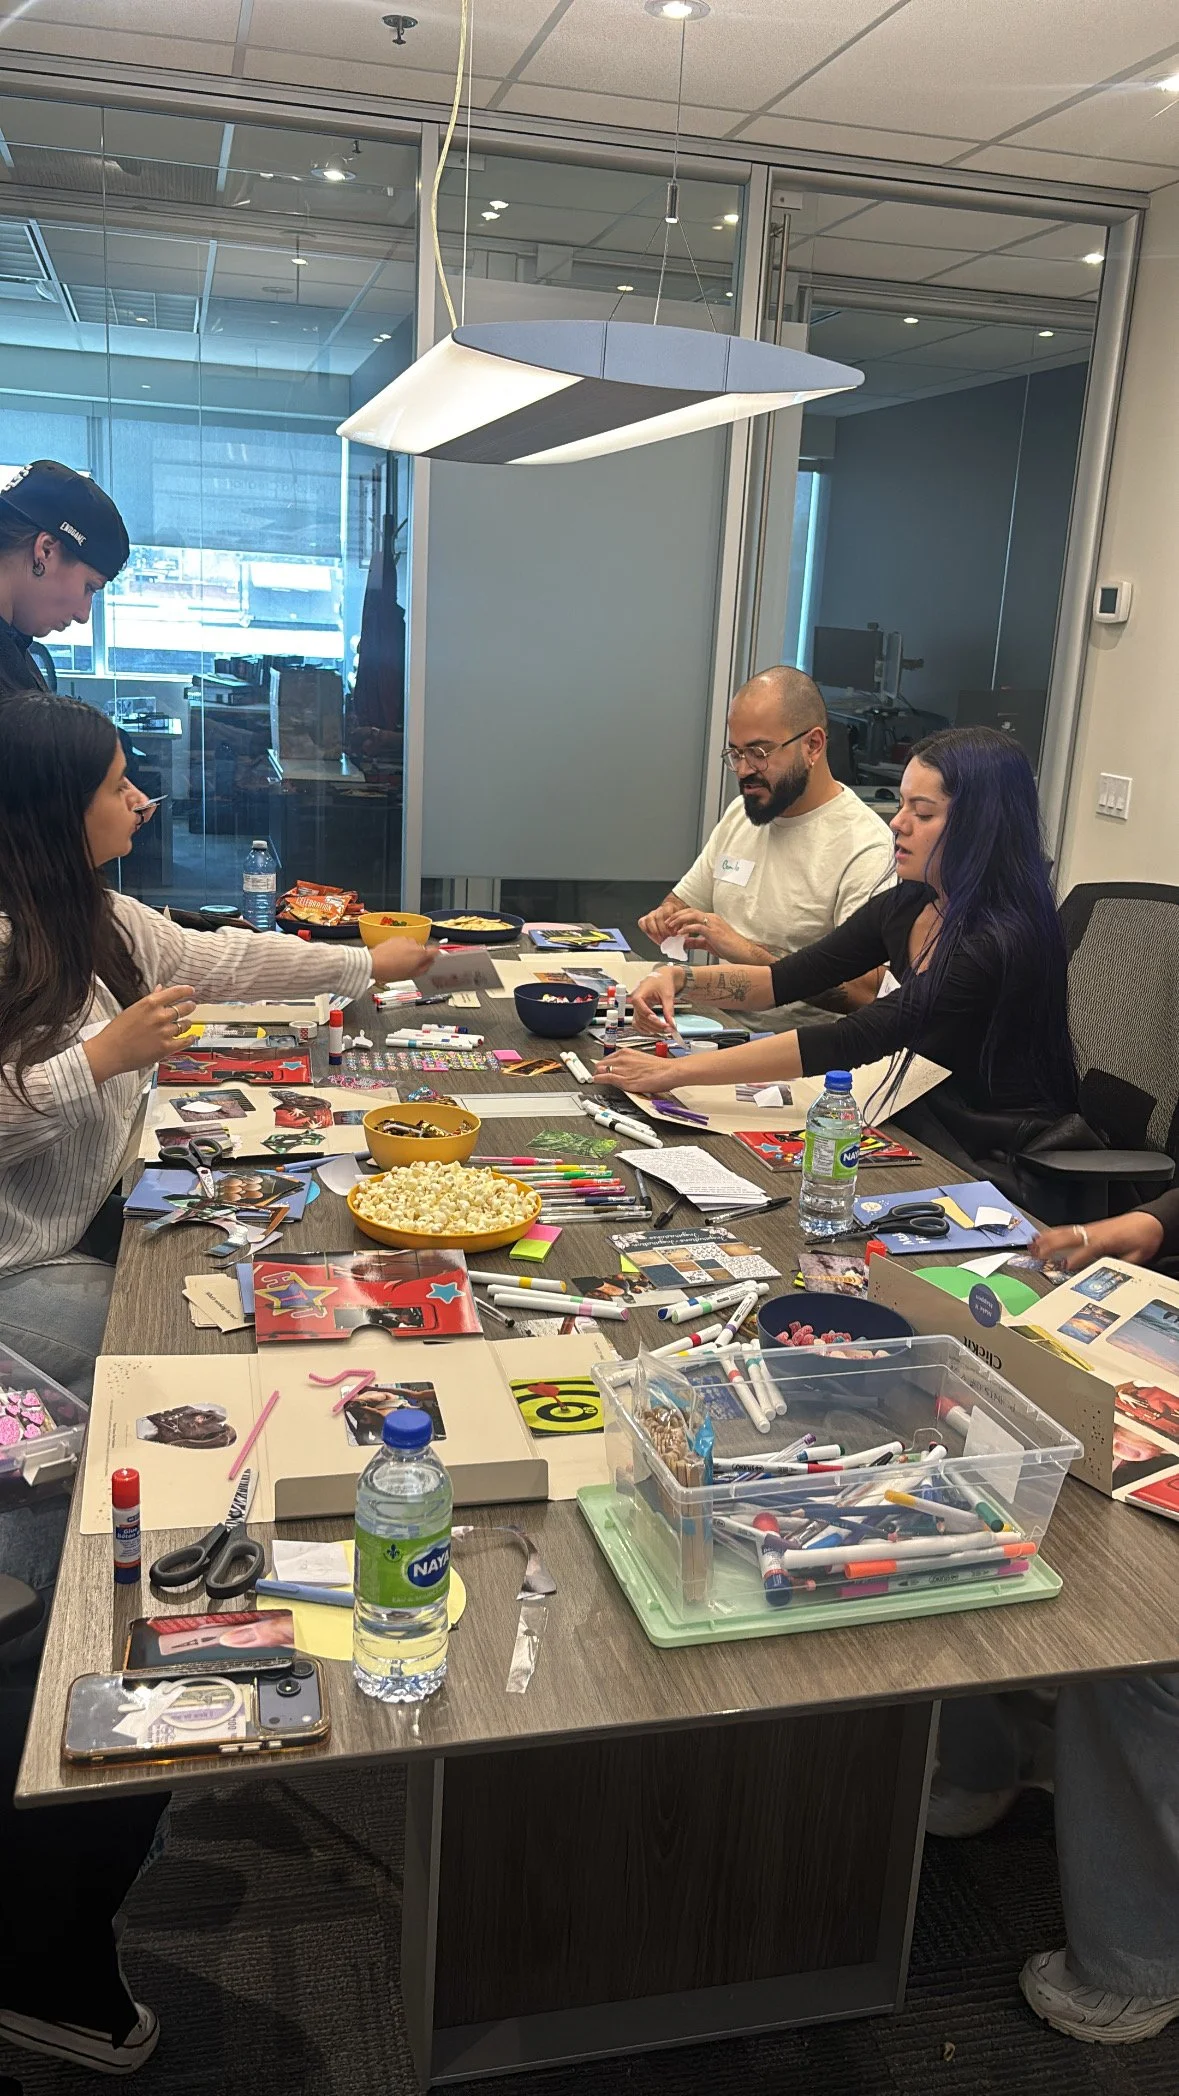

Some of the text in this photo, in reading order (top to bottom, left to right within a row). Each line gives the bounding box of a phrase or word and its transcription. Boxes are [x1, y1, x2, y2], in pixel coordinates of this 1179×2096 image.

[60, 521, 87, 547] ENDGAME
[295, 896, 332, 912] CELEBRATION
[842, 1149, 859, 1161] NAY
[123, 1527, 138, 1535] Glue
[413, 1550, 450, 1578] NAYA
